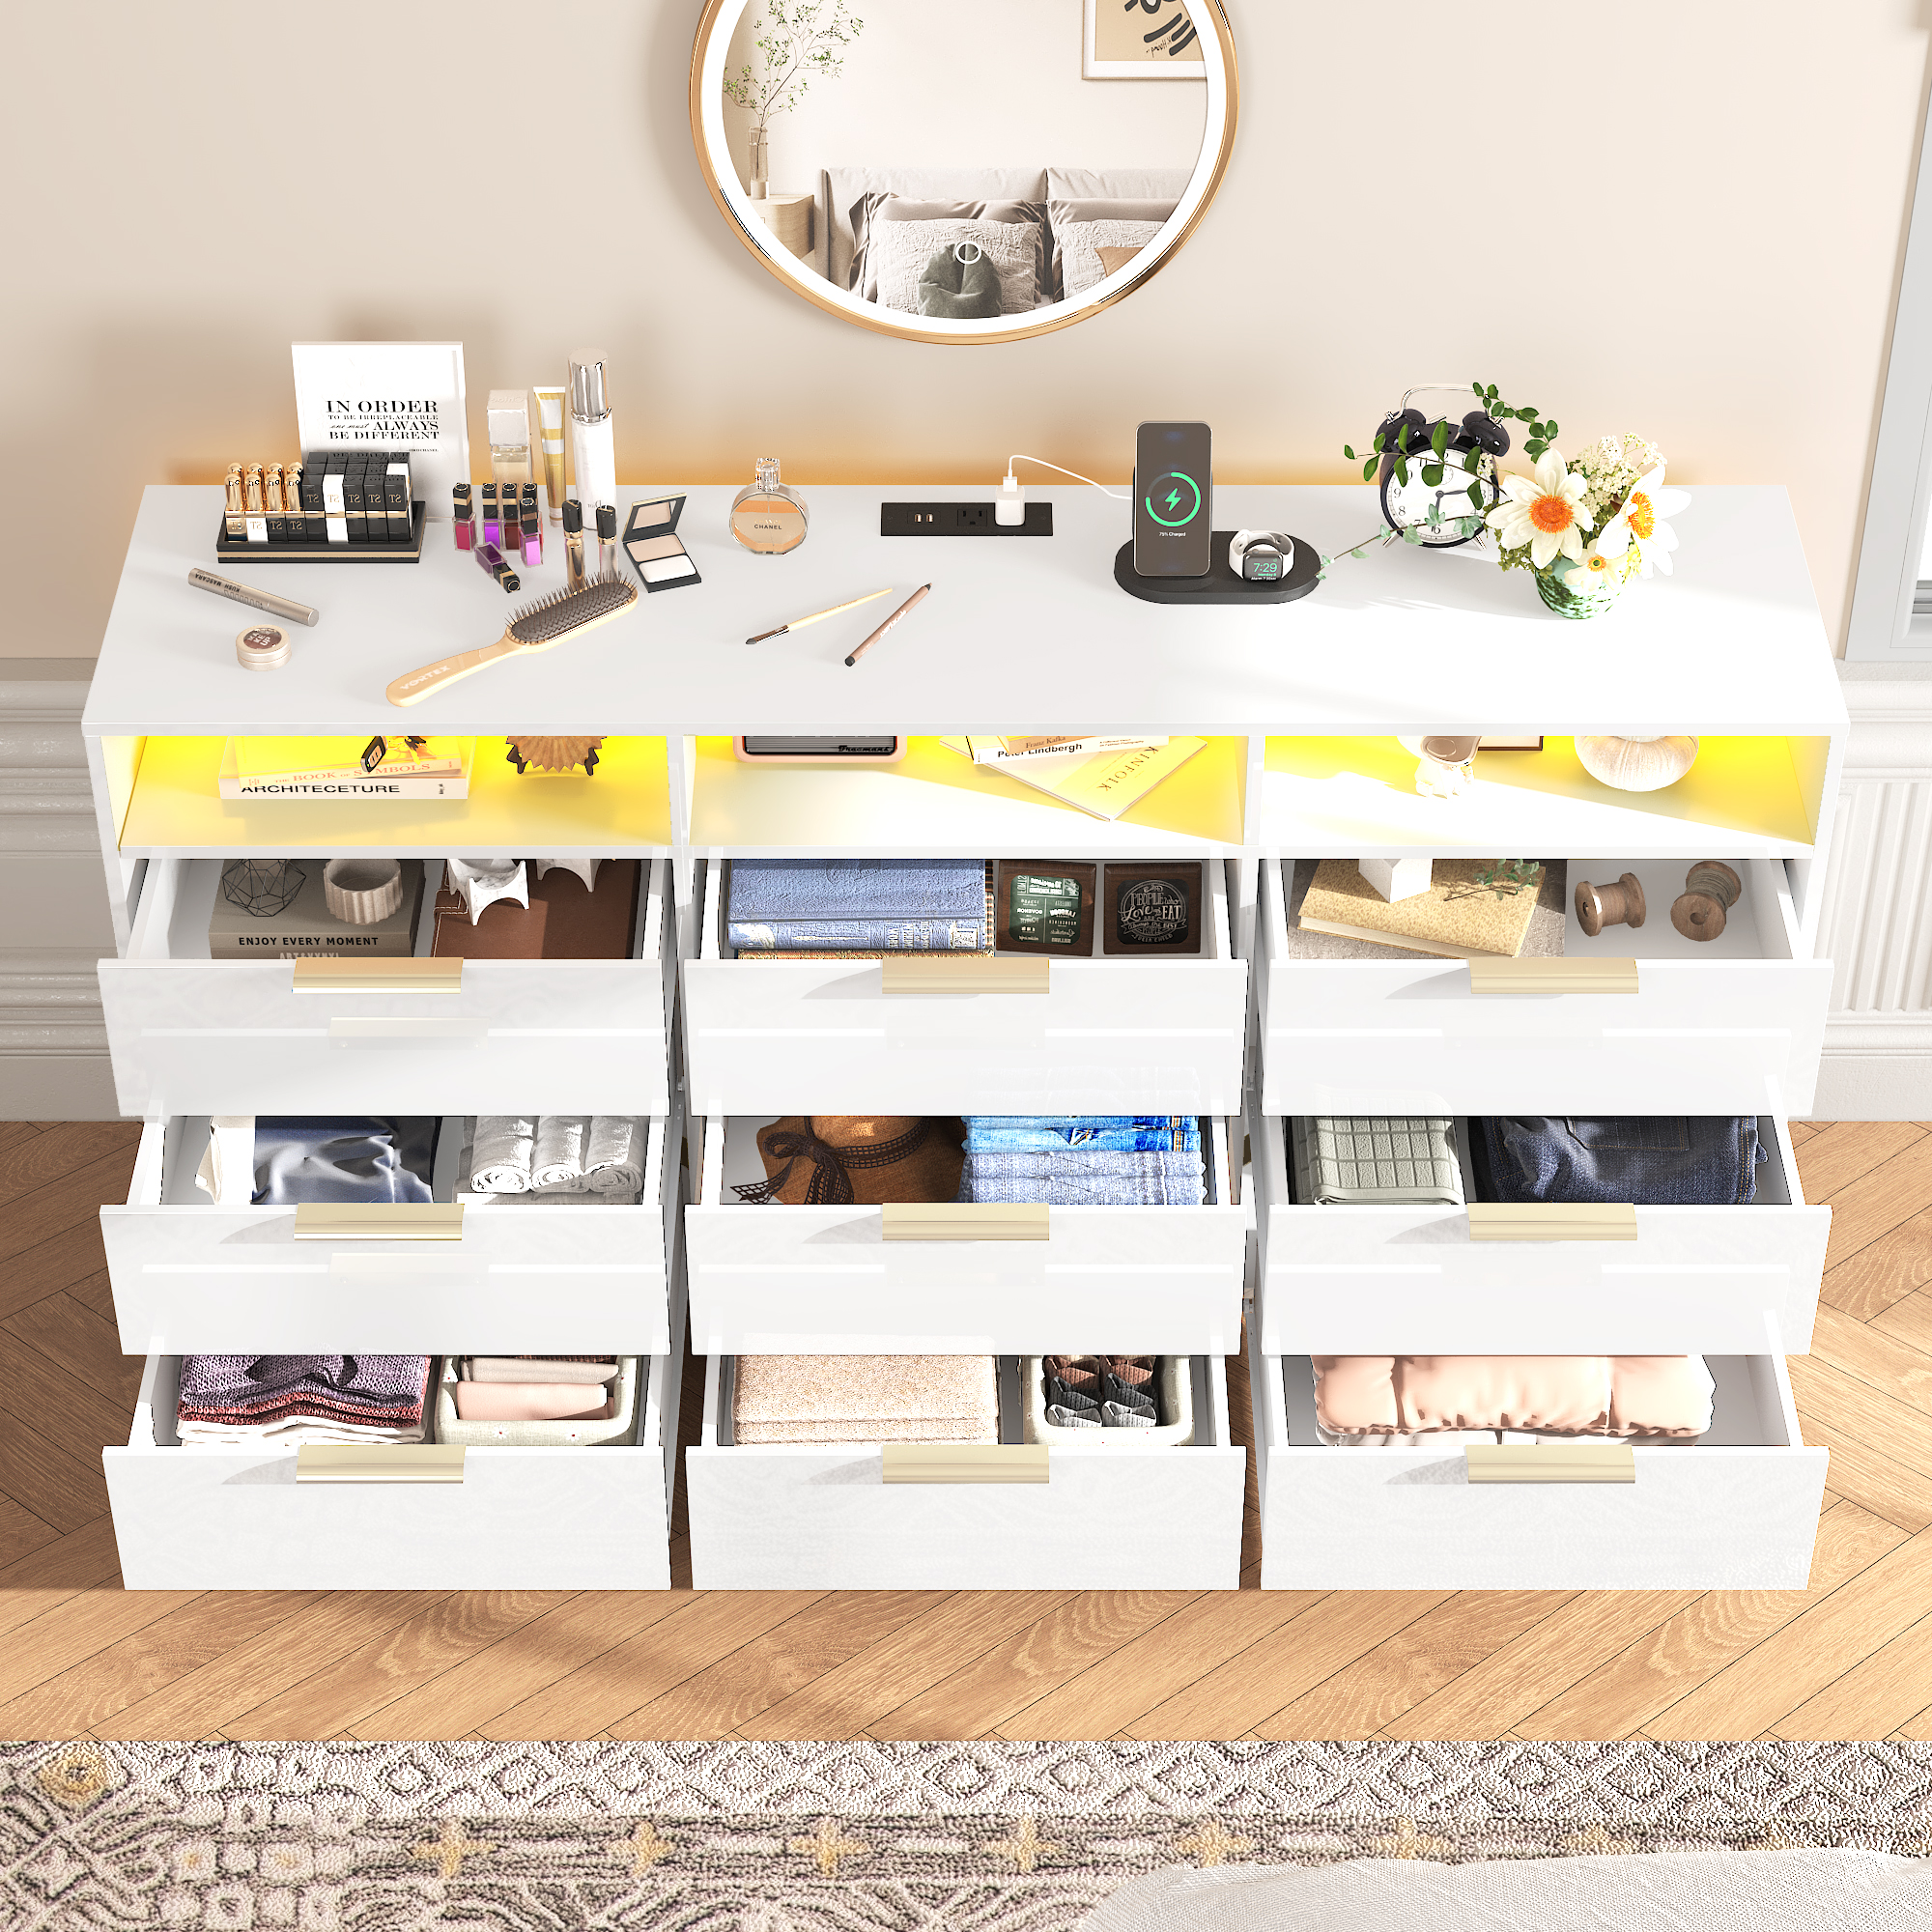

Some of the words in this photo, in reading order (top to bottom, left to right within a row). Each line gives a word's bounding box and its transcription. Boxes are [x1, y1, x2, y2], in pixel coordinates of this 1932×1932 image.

[326, 401, 351, 412] IN
[357, 400, 439, 412] ORDER
[373, 421, 439, 431] ALWAYS
[329, 431, 350, 440] BE
[355, 431, 440, 440] DIFFERENT
[1393, 488, 1402, 498] 9
[1398, 505, 1406, 516] 8
[1433, 525, 1441, 535] 6
[1253, 562, 1278, 573] 7:29
[194, 573, 222, 586] MASCARA
[224, 582, 242, 593] KUSH
[1025, 740, 1045, 749] Franz
[1046, 735, 1066, 745] Kafka
[1028, 743, 1083, 753] Lindbergh
[293, 772, 337, 782] BOOK
[354, 763, 431, 777] SMBOLS
[1095, 745, 1159, 792] KINFOLK
[1130, 892, 1165, 906] PEOPLE
[1118, 904, 1154, 923] Love
[1162, 905, 1181, 920] EAT
[238, 936, 278, 946] ENJOY
[282, 936, 321, 946] EVERY
[327, 936, 380, 946] MOMENT
